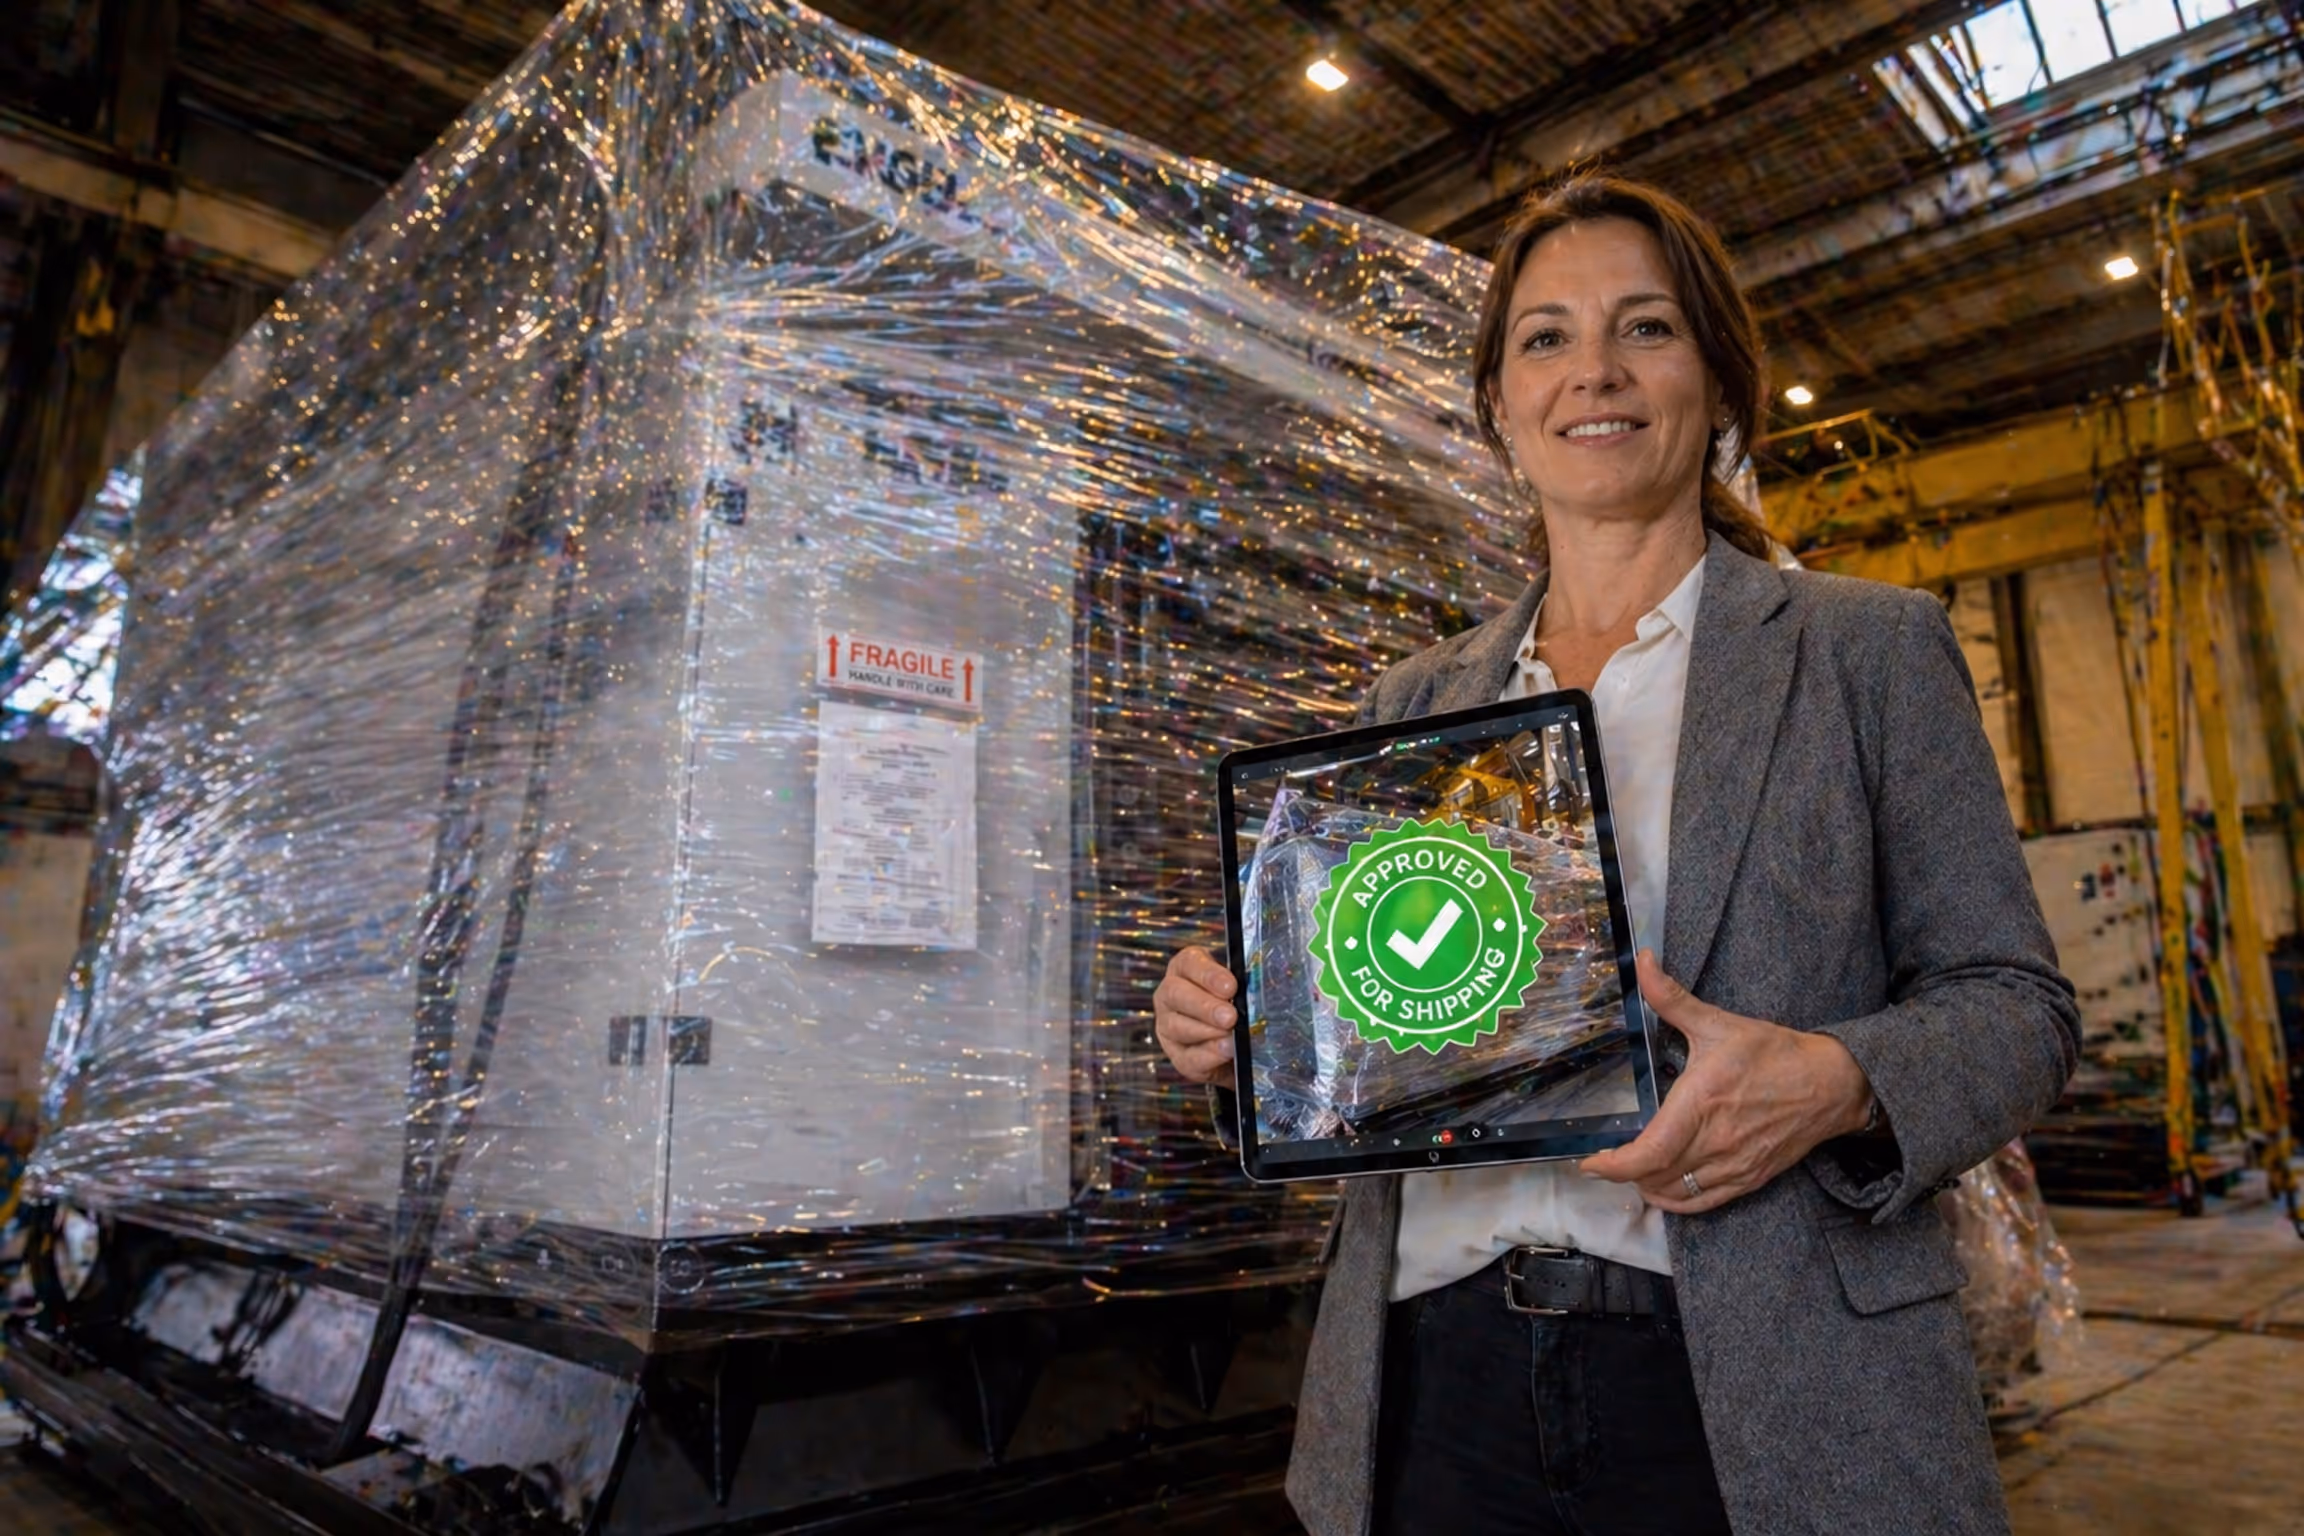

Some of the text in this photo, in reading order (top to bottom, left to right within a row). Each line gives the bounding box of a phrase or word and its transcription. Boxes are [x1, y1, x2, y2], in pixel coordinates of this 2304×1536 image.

[848, 669, 956, 699] HANDLE WITH CARE
[850, 641, 955, 680] FRAGILE
[1353, 849, 1487, 908] APPROVED
[1351, 947, 1505, 1021] FOR SHIPPING
